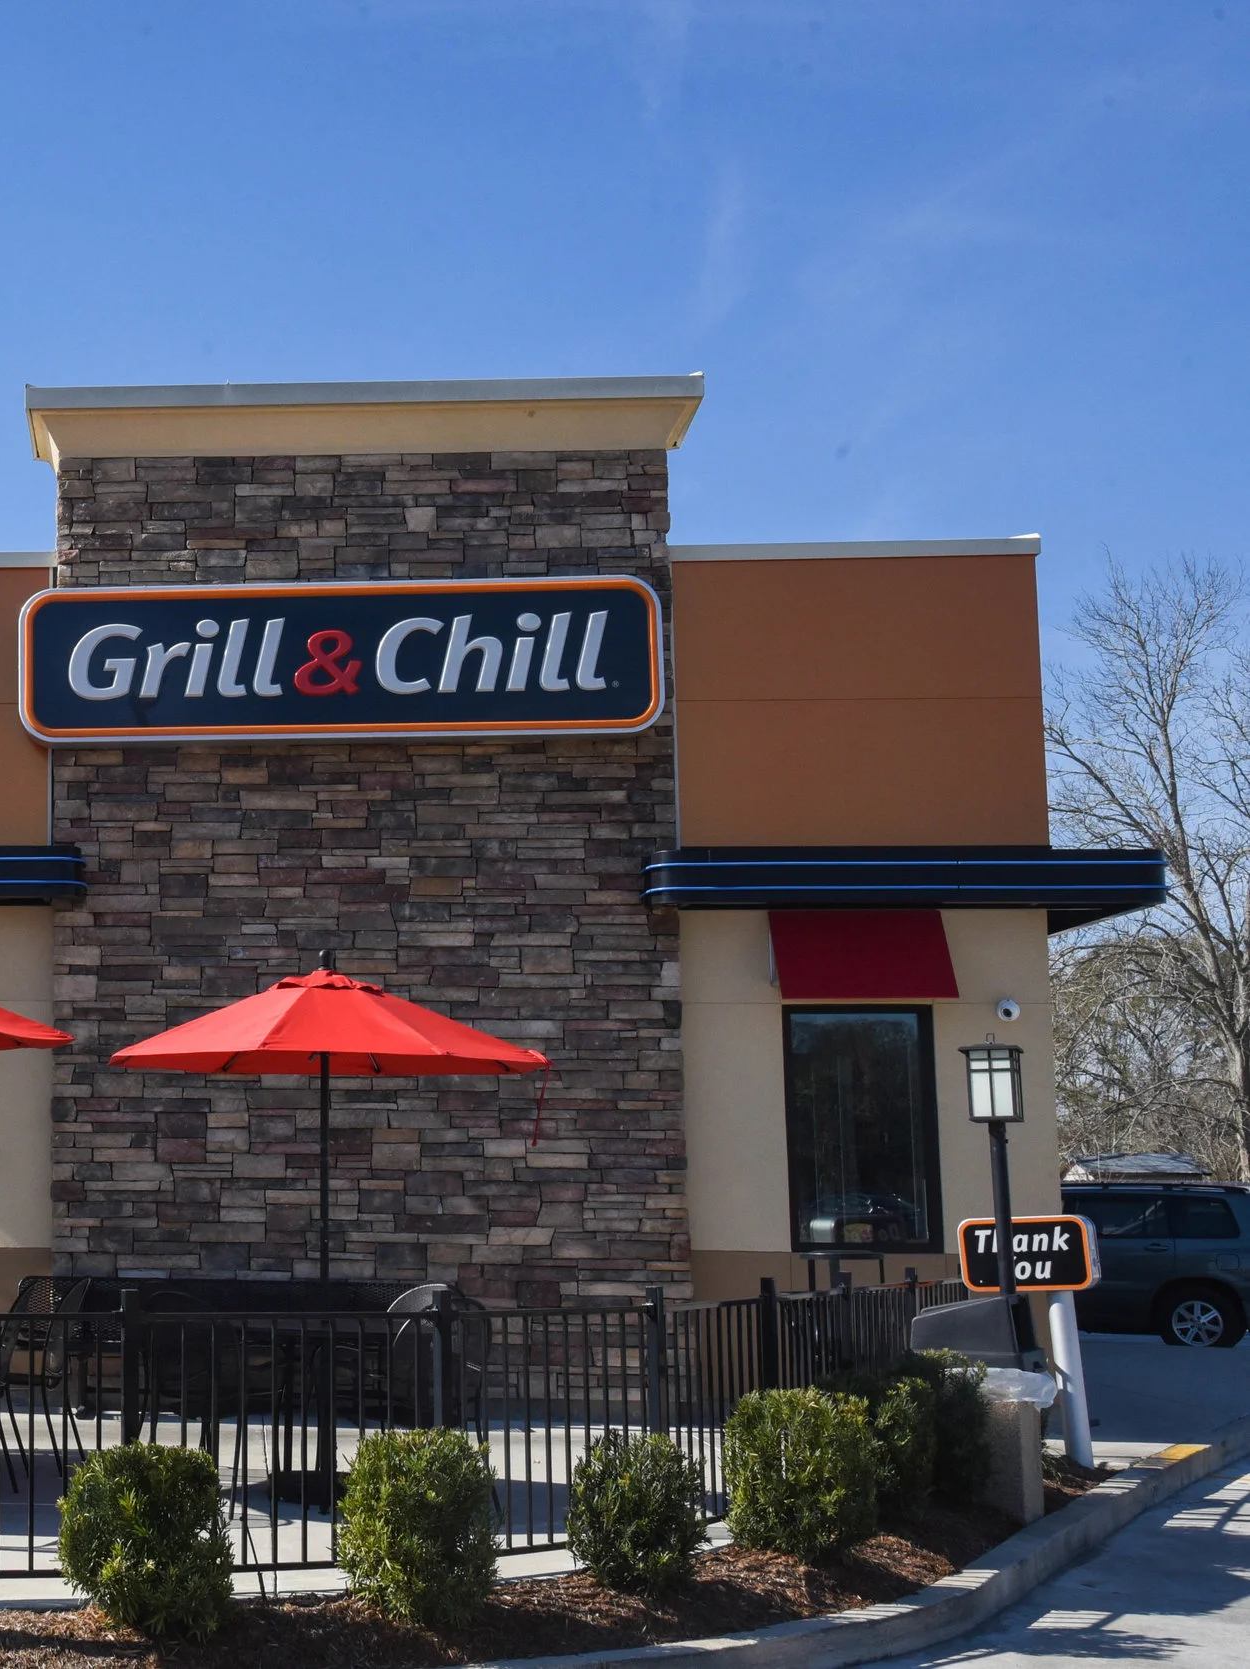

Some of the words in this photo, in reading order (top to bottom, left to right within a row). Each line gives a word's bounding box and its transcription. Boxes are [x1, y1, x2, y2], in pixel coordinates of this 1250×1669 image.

[68, 617, 286, 701] Grill
[294, 629, 362, 696] &
[375, 609, 610, 695] Chill
[1014, 1256, 1052, 1280] ou
